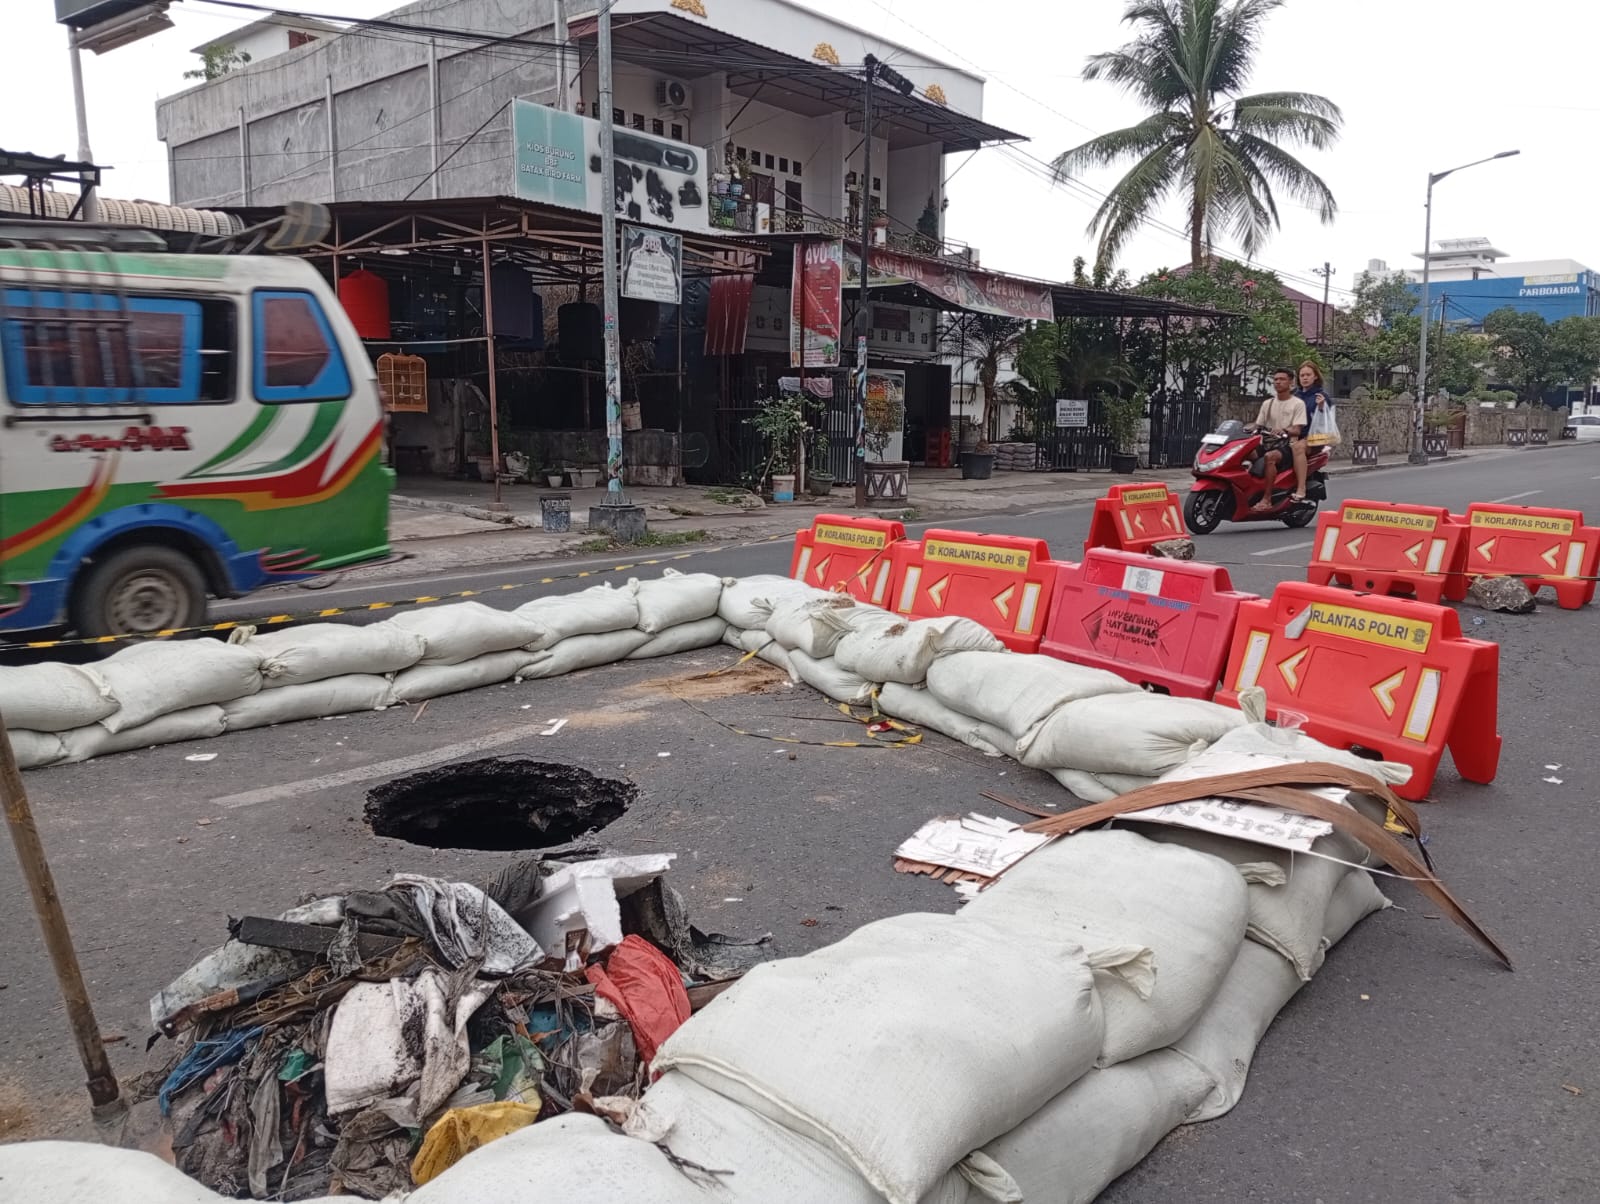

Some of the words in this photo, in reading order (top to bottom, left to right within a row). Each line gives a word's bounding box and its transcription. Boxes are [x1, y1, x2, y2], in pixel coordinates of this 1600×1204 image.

[527, 142, 545, 153] KIOS
[545, 146, 575, 160] BURUNG
[544, 169, 561, 179] BIRD
[562, 173, 582, 184] FARM
[805, 246, 827, 265] AYU
[874, 256, 901, 274] CAFE
[903, 262, 923, 279] AYU
[1009, 283, 1025, 298] AYU
[1519, 286, 1580, 297] PARBOABOA
[1355, 512, 1399, 524] KORLANTAS
[1400, 517, 1424, 527] POLRI
[1484, 516, 1533, 528] KORLANTAS
[1535, 521, 1560, 530] POLRI
[824, 530, 856, 542] KORLANTAS
[856, 534, 875, 545] POLRI
[938, 546, 986, 562] KORLANTAS
[988, 552, 1015, 565] POLRI
[1368, 622, 1409, 641] POLRI
